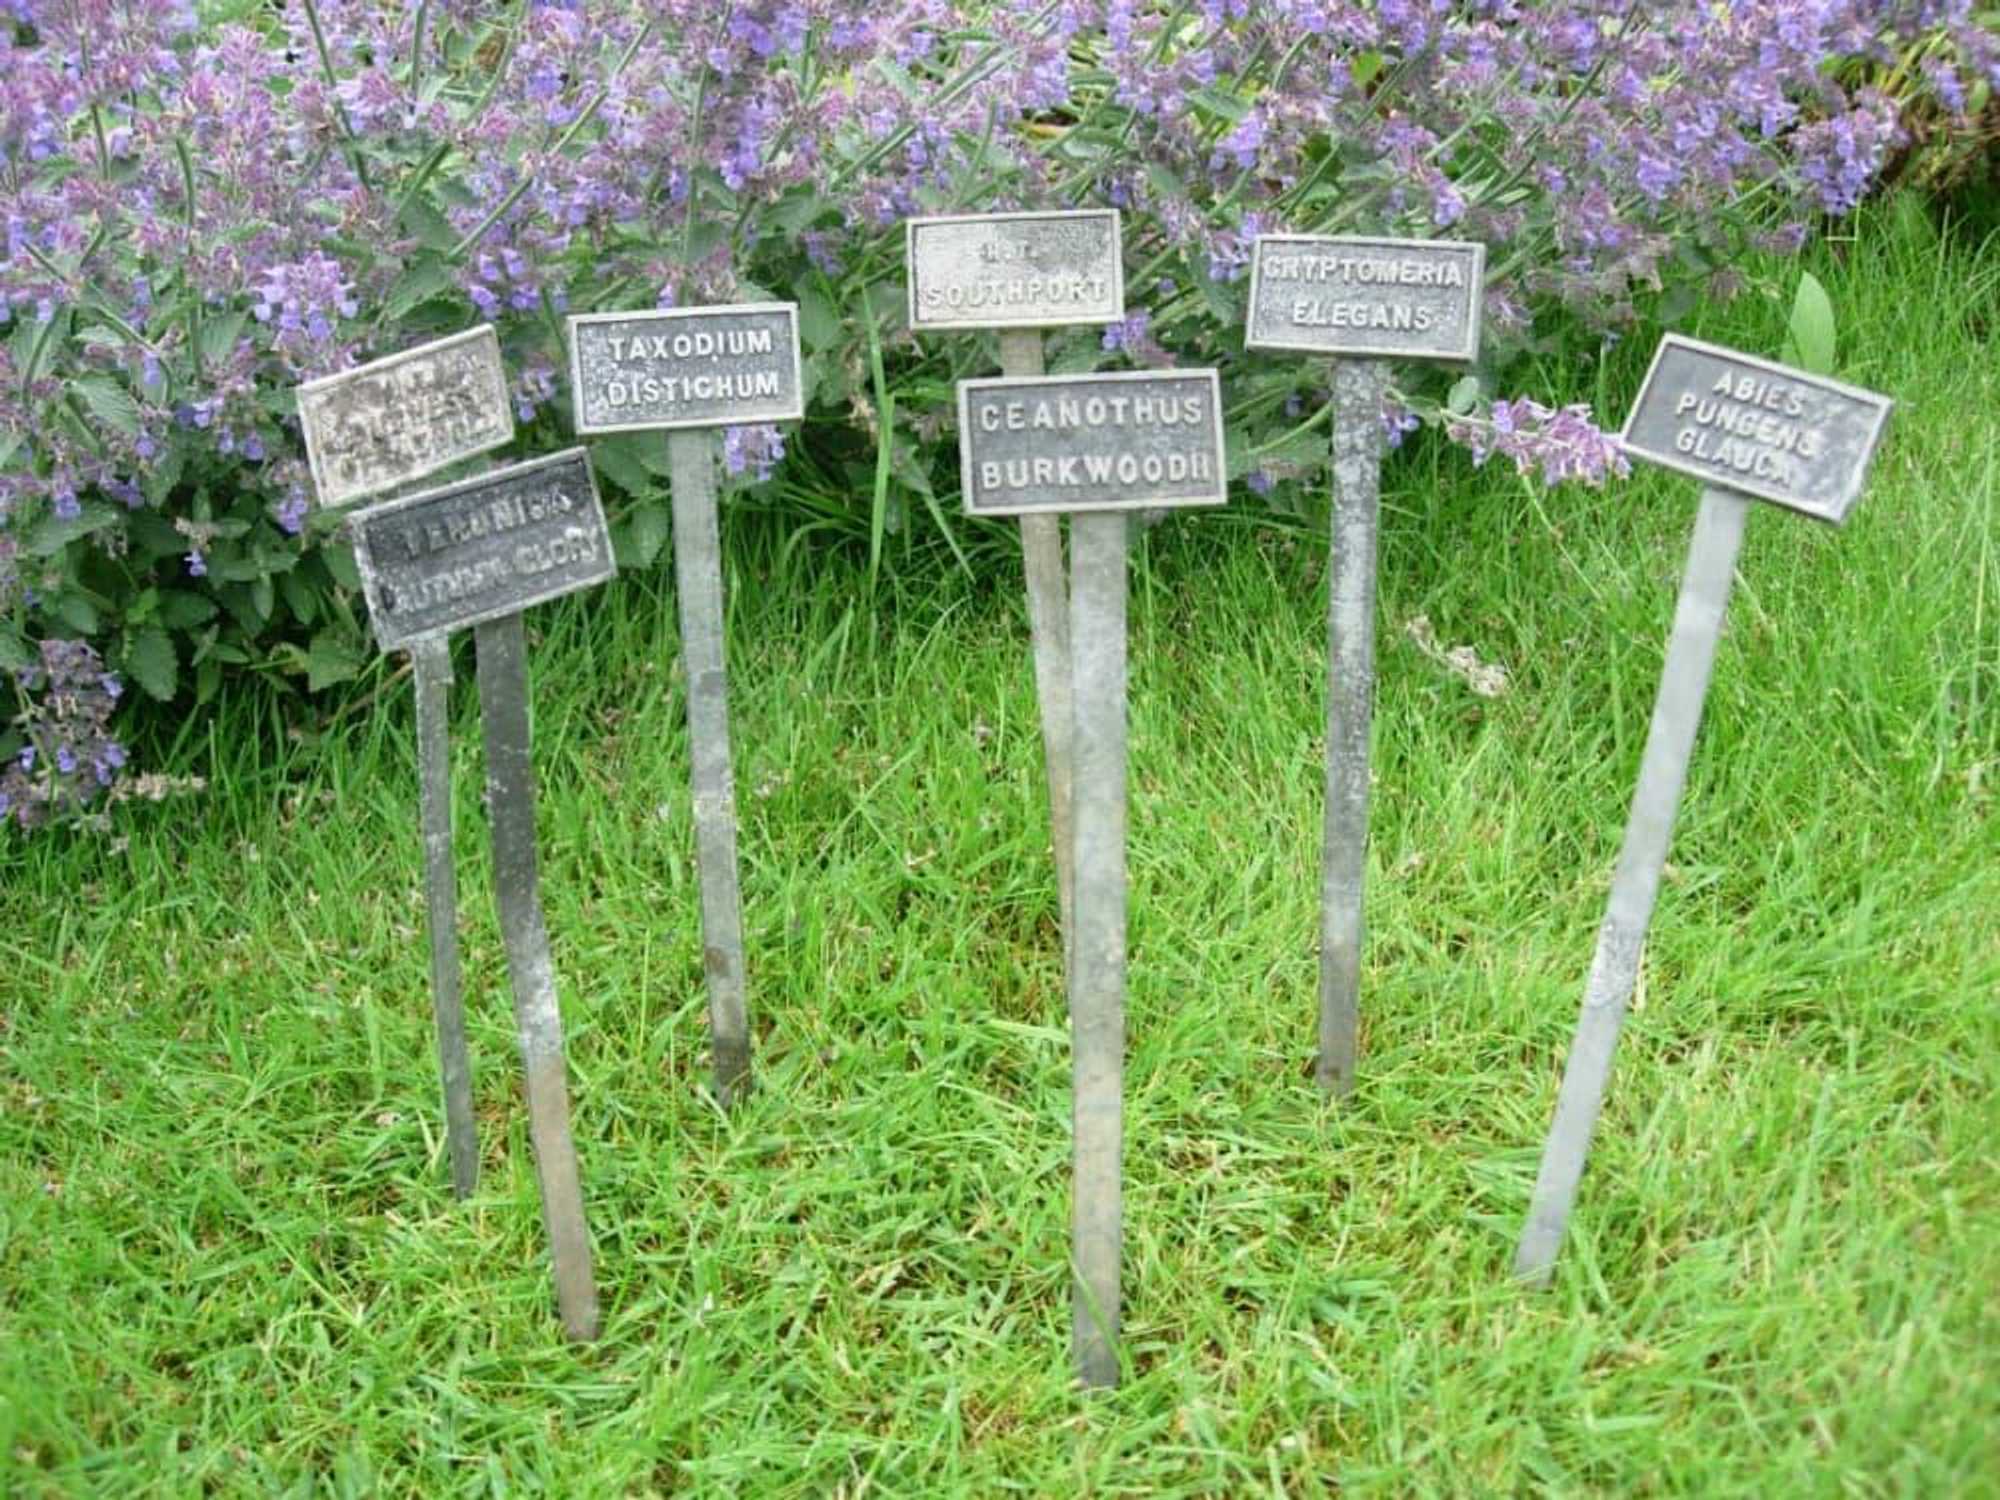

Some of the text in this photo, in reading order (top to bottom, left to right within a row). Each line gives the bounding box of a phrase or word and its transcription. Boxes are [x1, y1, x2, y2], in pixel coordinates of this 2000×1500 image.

[1263, 255, 1464, 288] CRYPTOMERIA
[925, 274, 1106, 307] SOUTHPORT
[1293, 300, 1432, 330] ELEGANS
[608, 329, 771, 361] TAXODIUM
[607, 371, 780, 406] DISTICHUM
[1711, 370, 1806, 415] ABIES
[980, 396, 1202, 432] CEANOTHUS
[1675, 392, 1824, 457] PUNGENS
[981, 452, 1211, 489] BURKWOODII
[1675, 428, 1793, 486] GLAUCA
